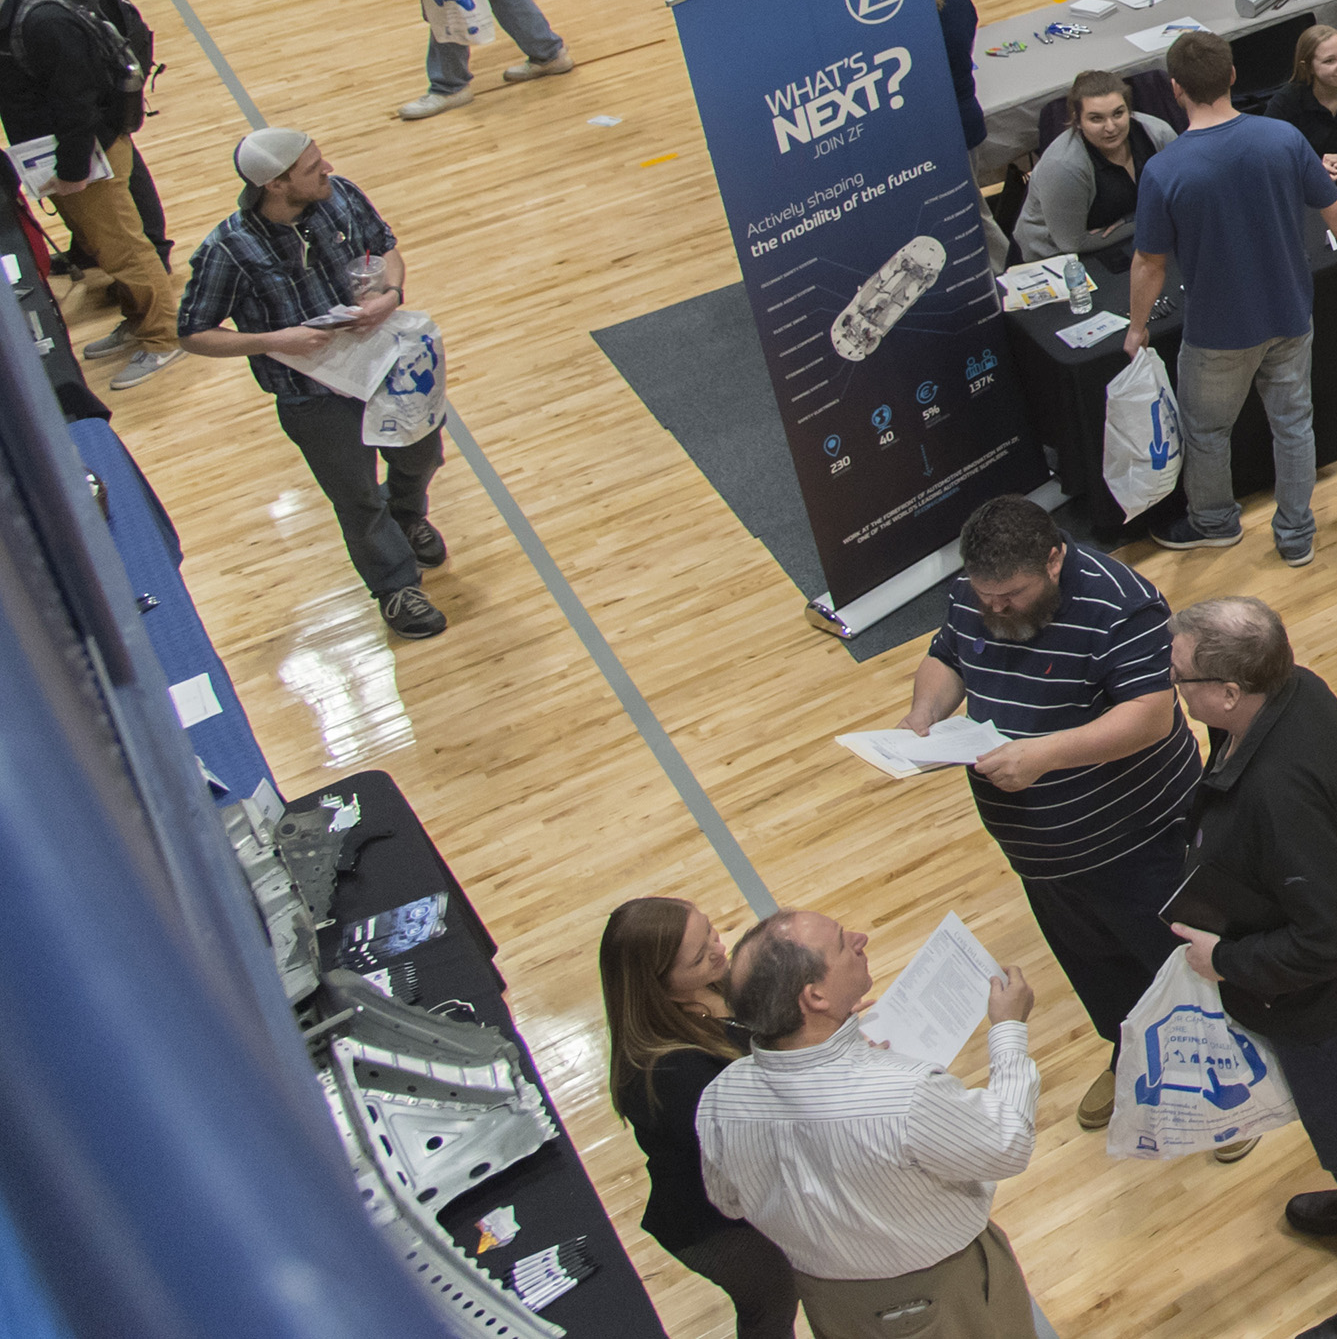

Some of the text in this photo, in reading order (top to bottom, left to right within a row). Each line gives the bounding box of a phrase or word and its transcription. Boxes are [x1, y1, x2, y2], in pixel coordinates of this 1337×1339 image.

[764, 51, 868, 116] WHAT'S
[772, 47, 912, 155] NEXT?
[813, 123, 864, 160] JOIN ZF
[747, 173, 864, 239] Actively shaping
[750, 160, 937, 257] the mobility of the future.
[922, 405, 940, 421] 5%
[969, 373, 995, 394] 137K
[830, 455, 851, 474] 230
[879, 430, 895, 445] 40
[843, 531, 861, 545] WORK
[862, 525, 869, 534] AT
[870, 517, 882, 528] THE
[883, 497, 917, 523] FOREFRONT
[917, 491, 926, 500] OF
[926, 472, 963, 494] AUTOMOTIVE
[963, 450, 996, 473] INNOVATION
[857, 532, 870, 544] ONE
[871, 526, 879, 536] OF
[880, 519, 892, 531] THE
[918, 490, 943, 508] LEADING
[943, 469, 980, 492] AUTOMOTIVE
